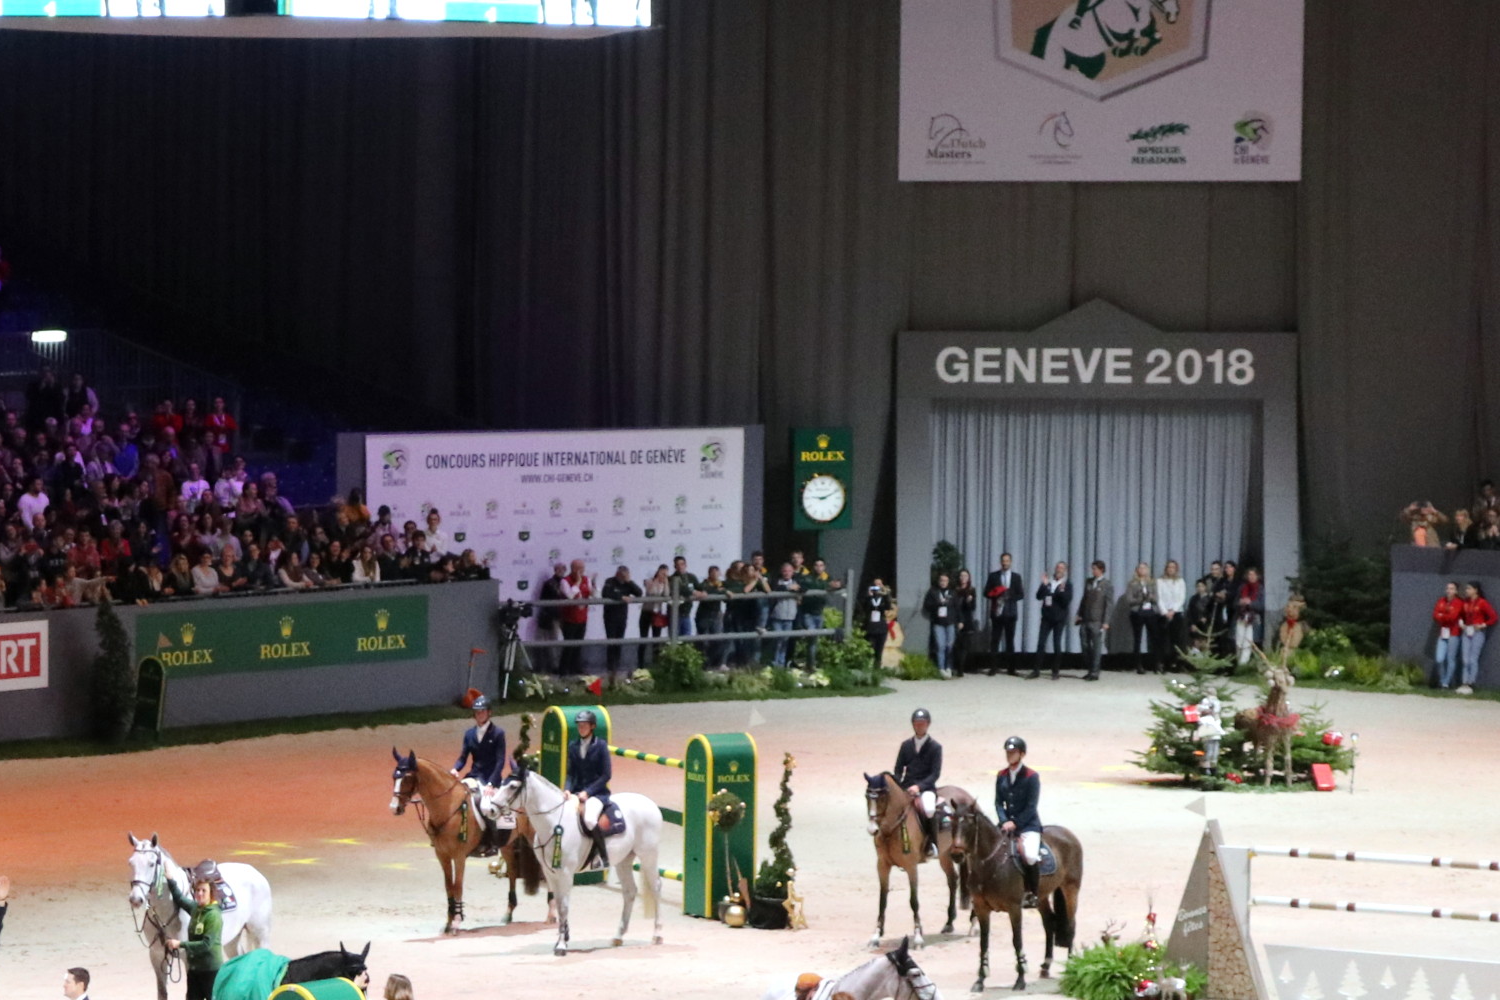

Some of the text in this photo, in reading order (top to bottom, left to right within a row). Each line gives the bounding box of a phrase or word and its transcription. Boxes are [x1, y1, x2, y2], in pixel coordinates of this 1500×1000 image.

[935, 346, 1255, 385] GENEVE 2018
[425, 446, 686, 469] CONCOURS HIPPIQUE INTERNATIONAL DE GENÈVE
[801, 450, 845, 461] ROLEX
[260, 641, 311, 660] ROLEX
[356, 633, 407, 652] ROLEX
[717, 774, 750, 783] ROLEX
